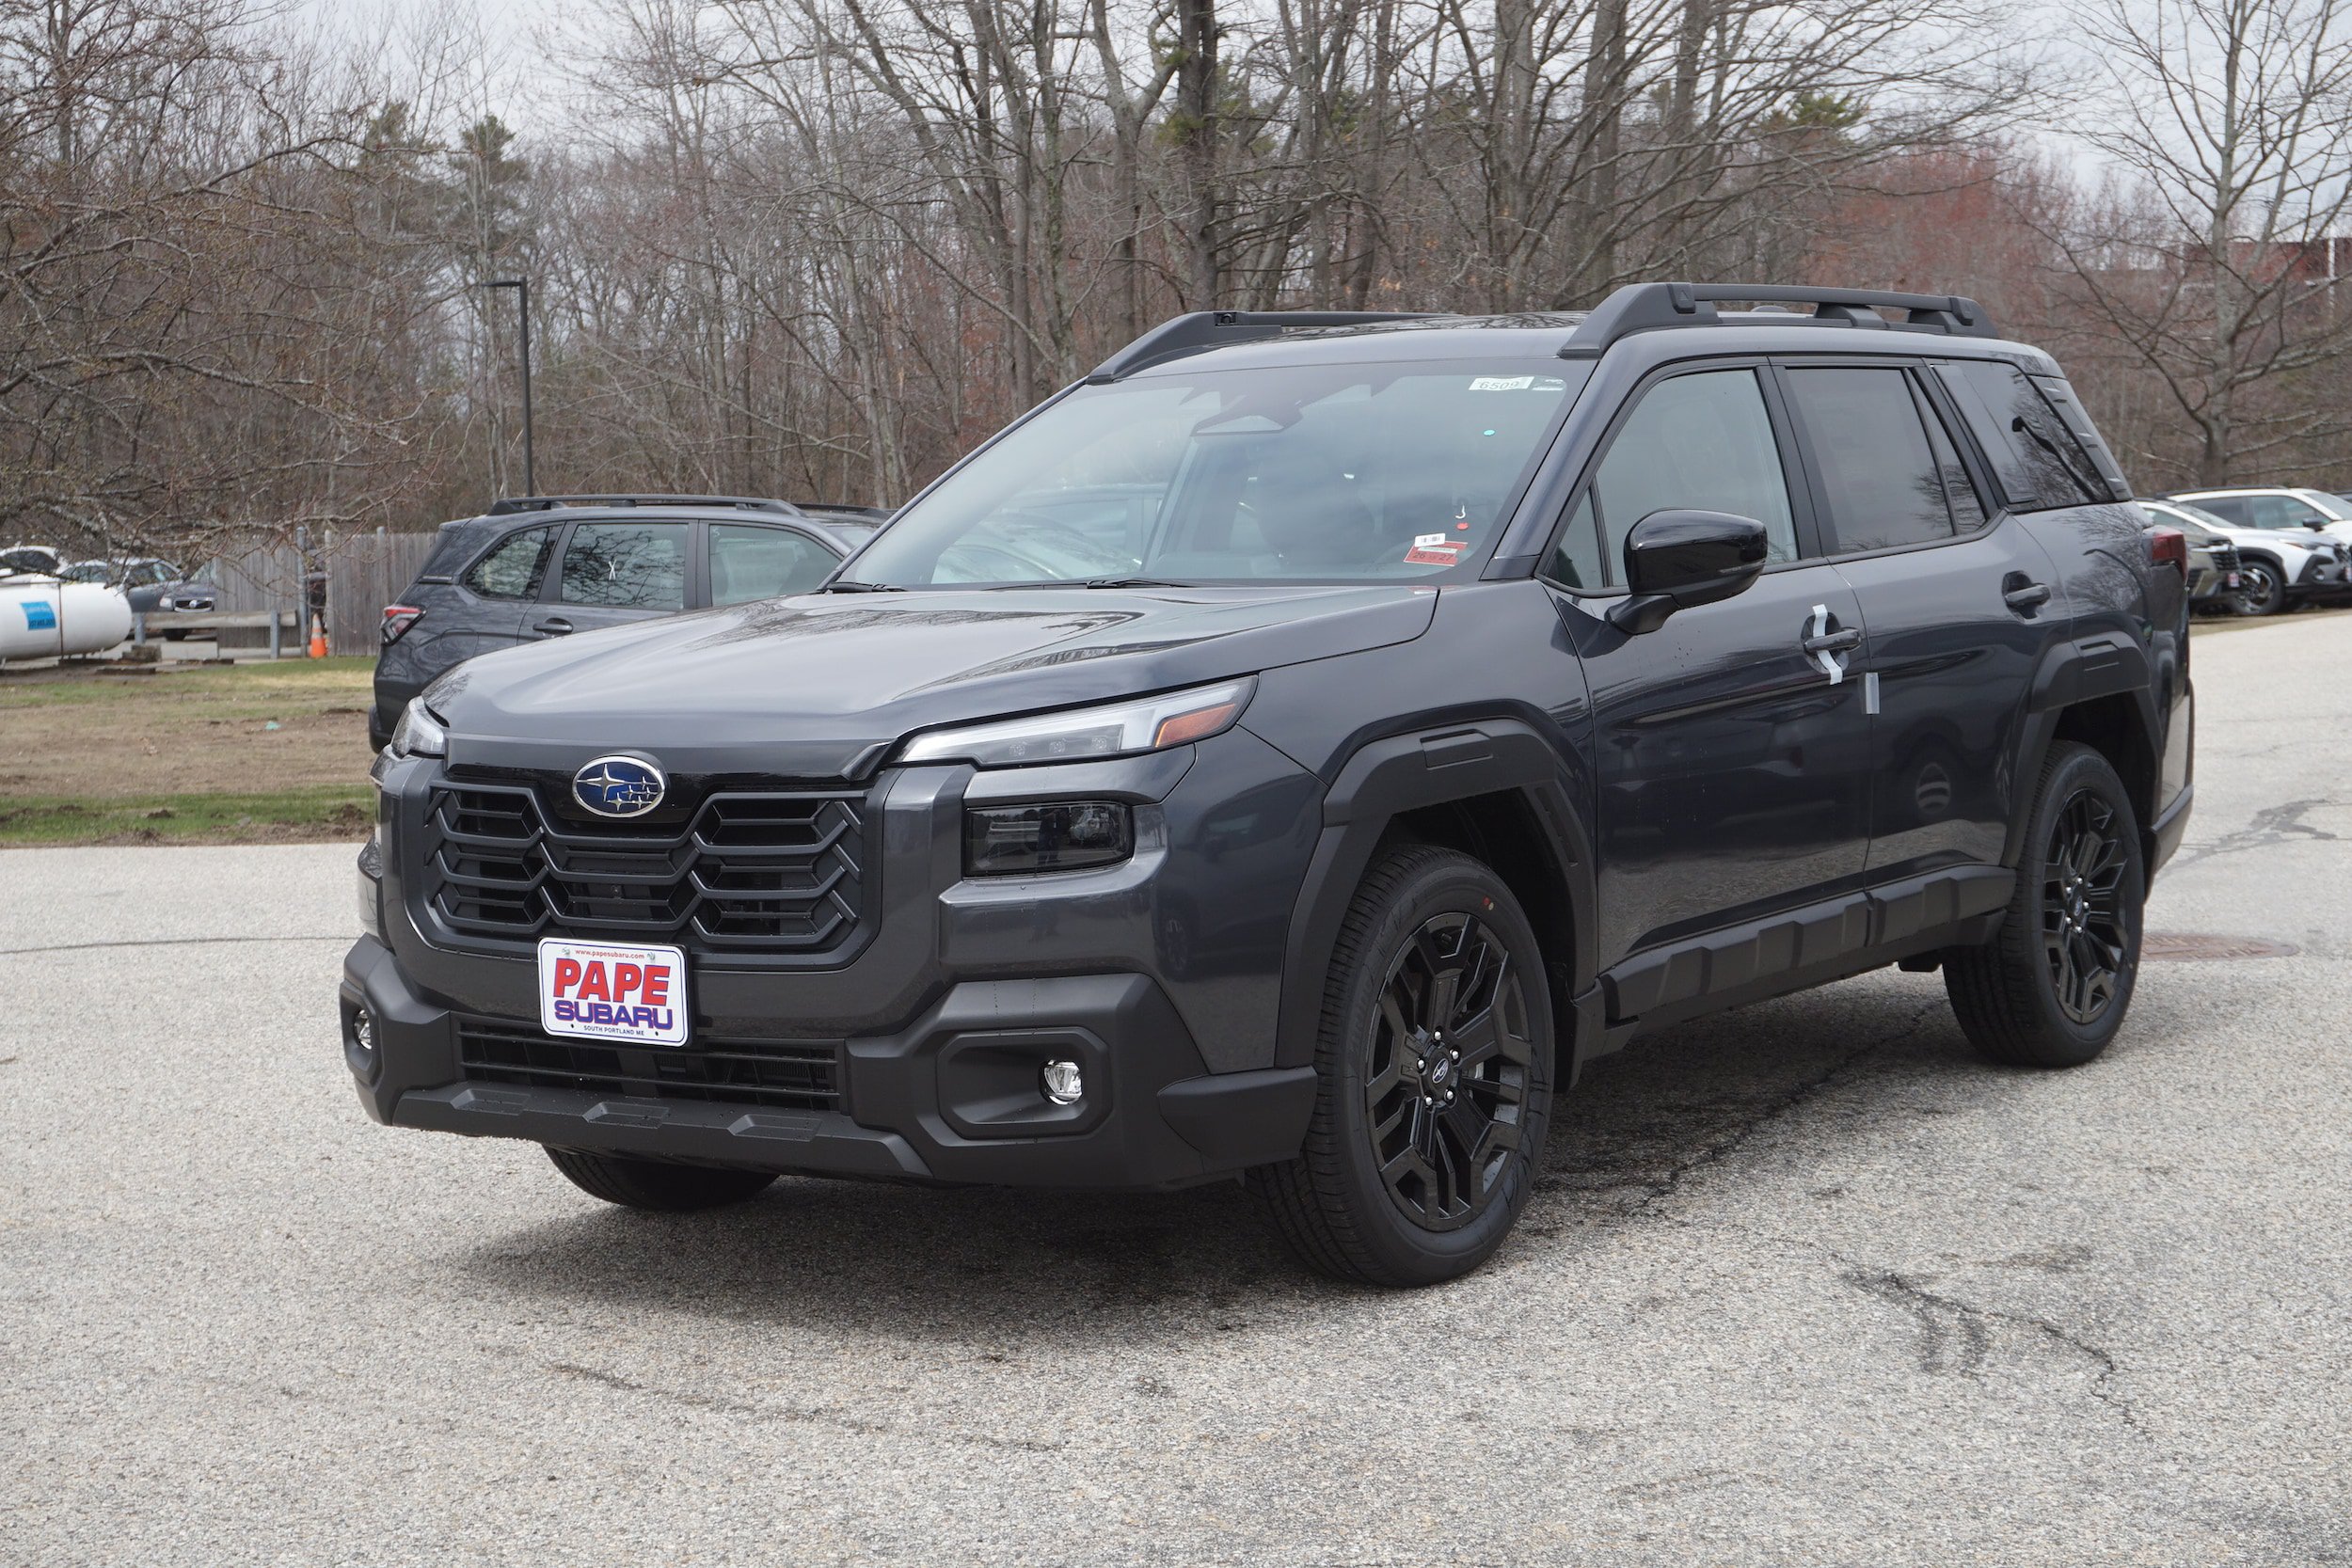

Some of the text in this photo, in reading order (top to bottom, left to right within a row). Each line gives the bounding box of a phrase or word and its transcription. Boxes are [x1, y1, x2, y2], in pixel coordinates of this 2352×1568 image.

[1479, 380, 1520, 390] 6509
[575, 948, 645, 959] www.papesubaru.com
[553, 958, 671, 1006] PAPE
[554, 1000, 674, 1031] SUBARU
[604, 1026, 634, 1036] PORTLAND
